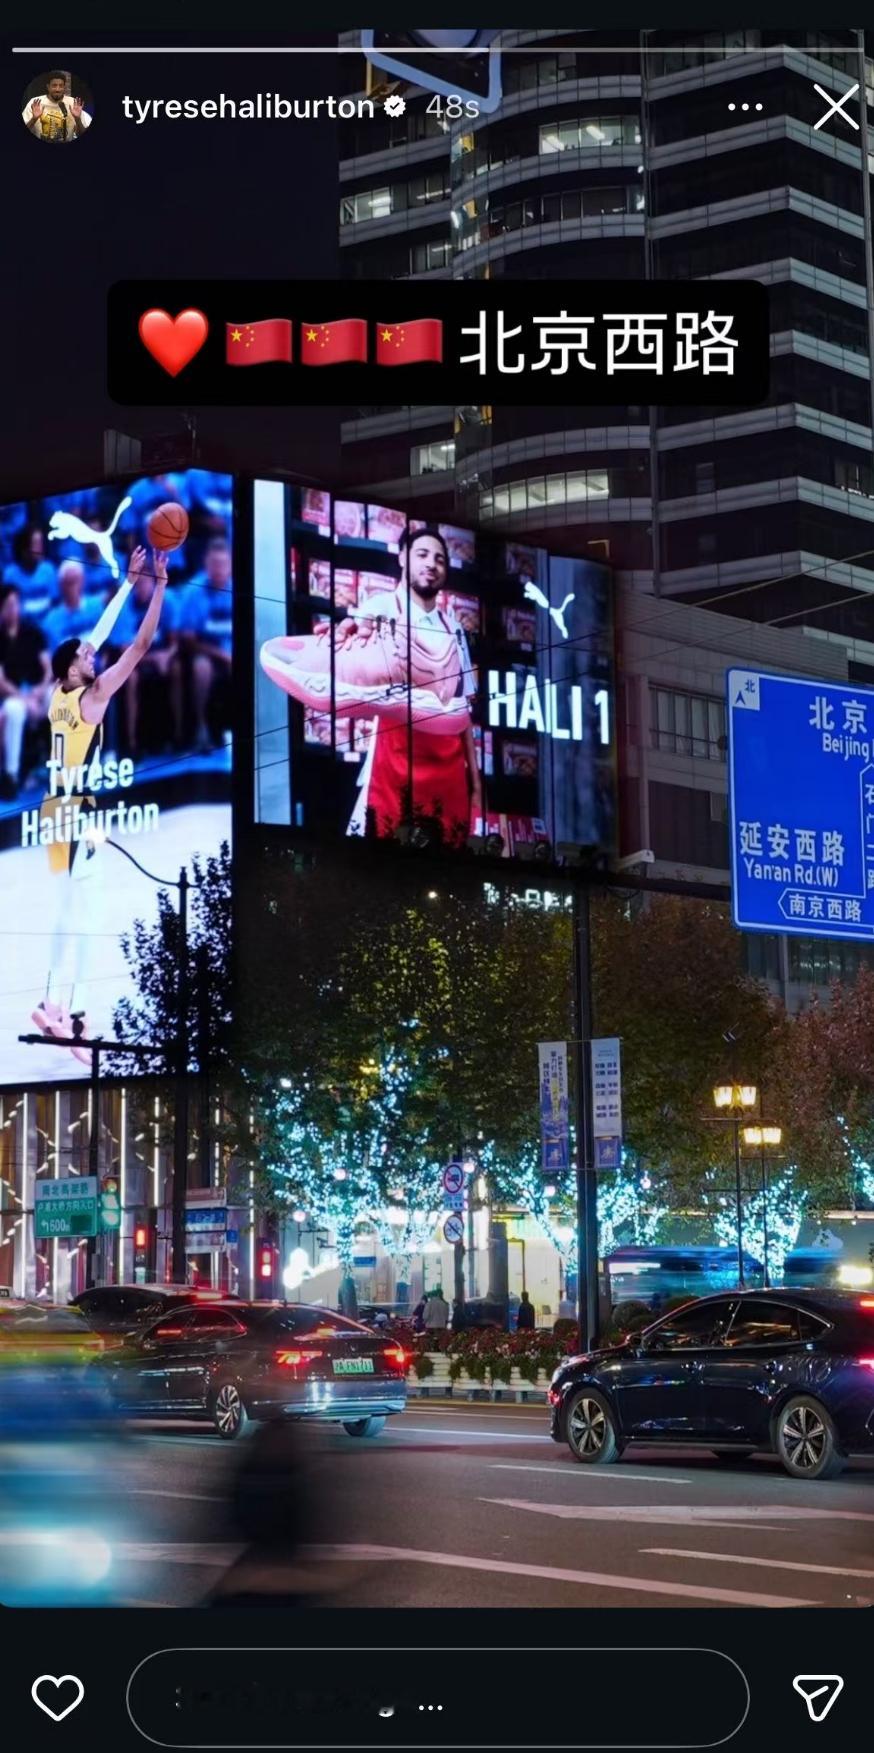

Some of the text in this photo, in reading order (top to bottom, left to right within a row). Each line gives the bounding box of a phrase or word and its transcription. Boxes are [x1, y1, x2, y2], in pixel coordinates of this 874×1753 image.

[745, 680, 756, 693] 北
[488, 670, 609, 745] HALI 1
[809, 696, 868, 734] 北京
[822, 733, 869, 764] Beijing
[46, 758, 134, 803] Tyrese
[21, 801, 159, 847] Haliburton
[739, 821, 845, 866] 延安西路
[744, 857, 839, 888] Yan'an Rd.(W)
[788, 893, 862, 922] 南京西路
